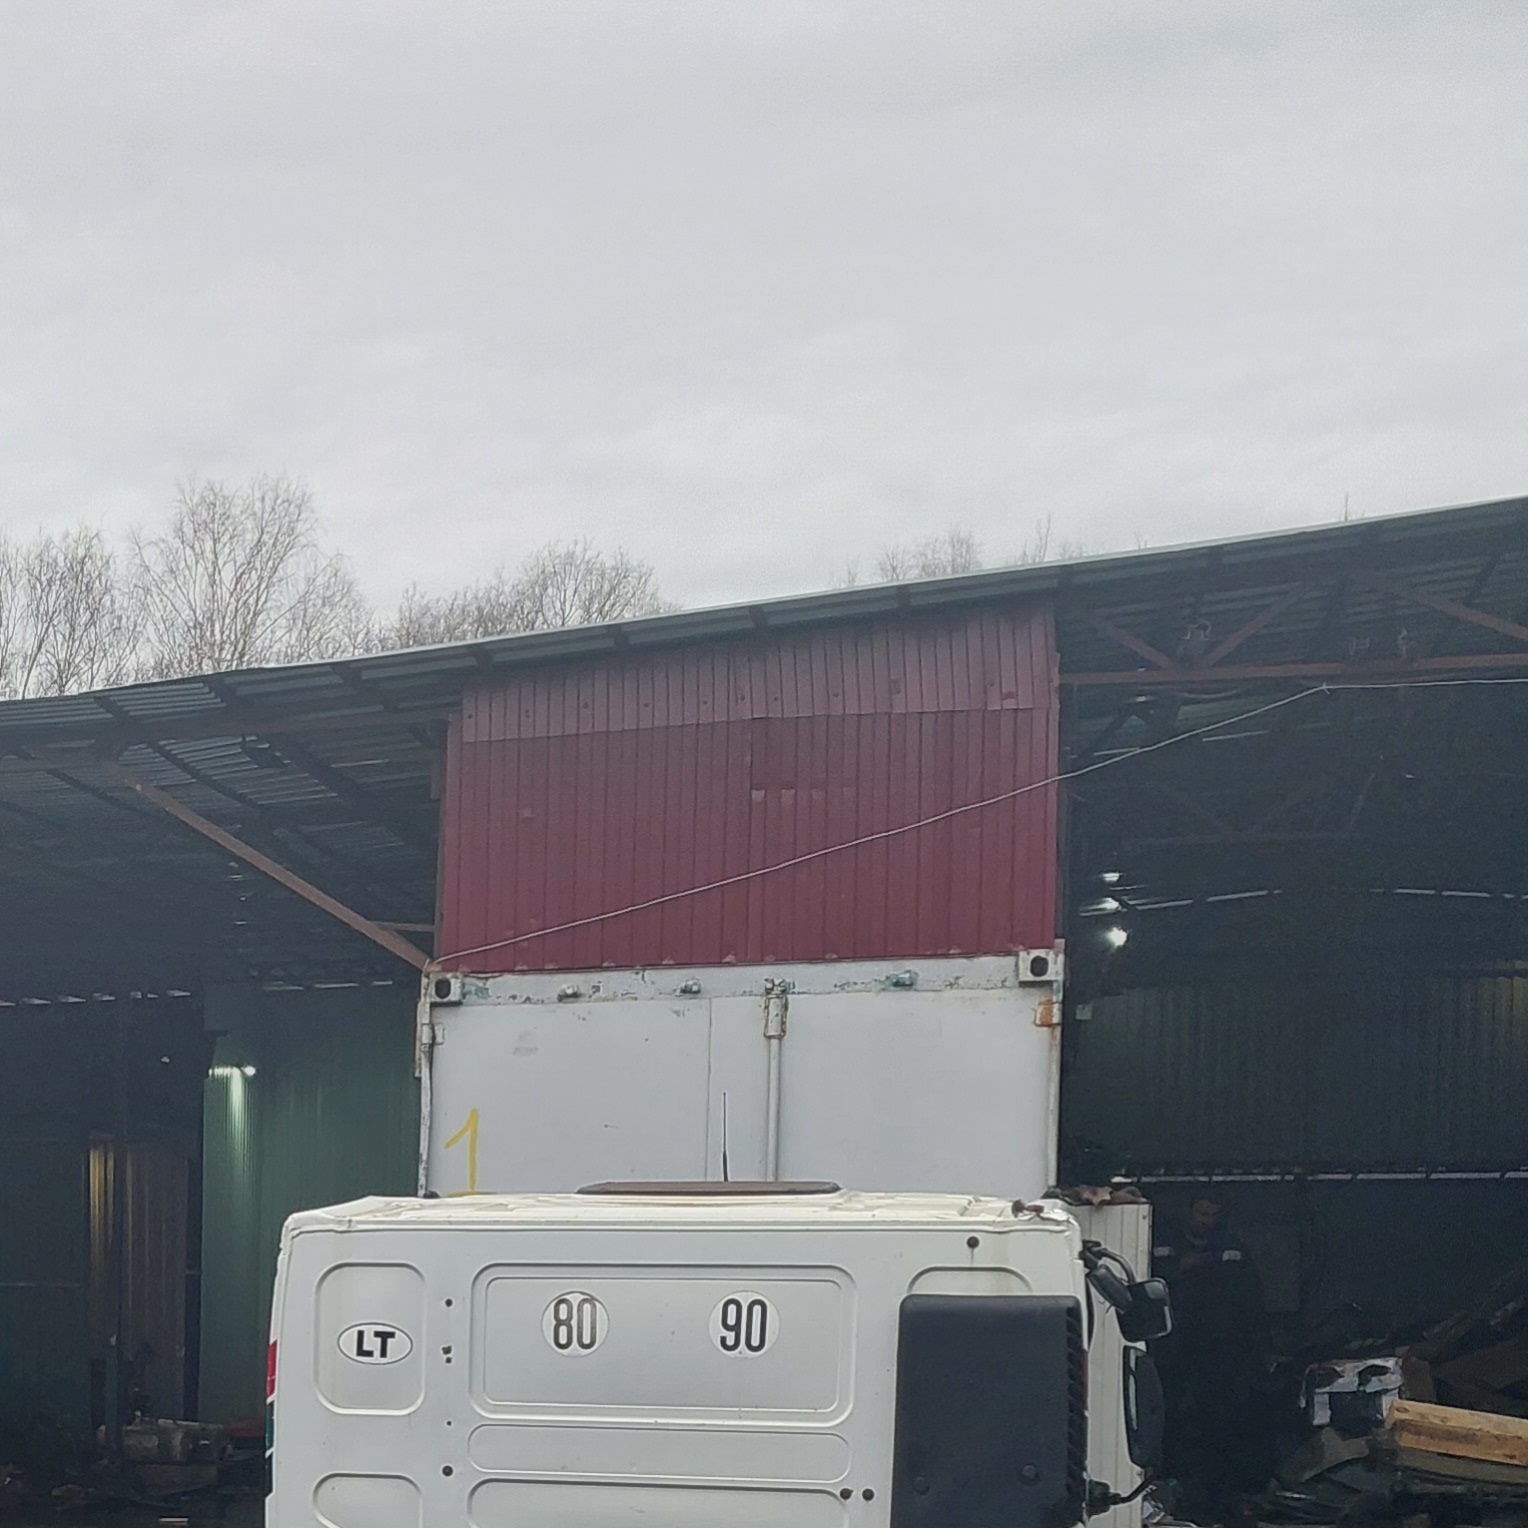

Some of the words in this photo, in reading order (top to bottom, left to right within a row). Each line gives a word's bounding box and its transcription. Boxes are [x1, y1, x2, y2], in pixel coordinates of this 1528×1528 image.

[356, 1329, 396, 1359] LT
[554, 1298, 597, 1350] 80
[720, 1298, 768, 1353] 90
